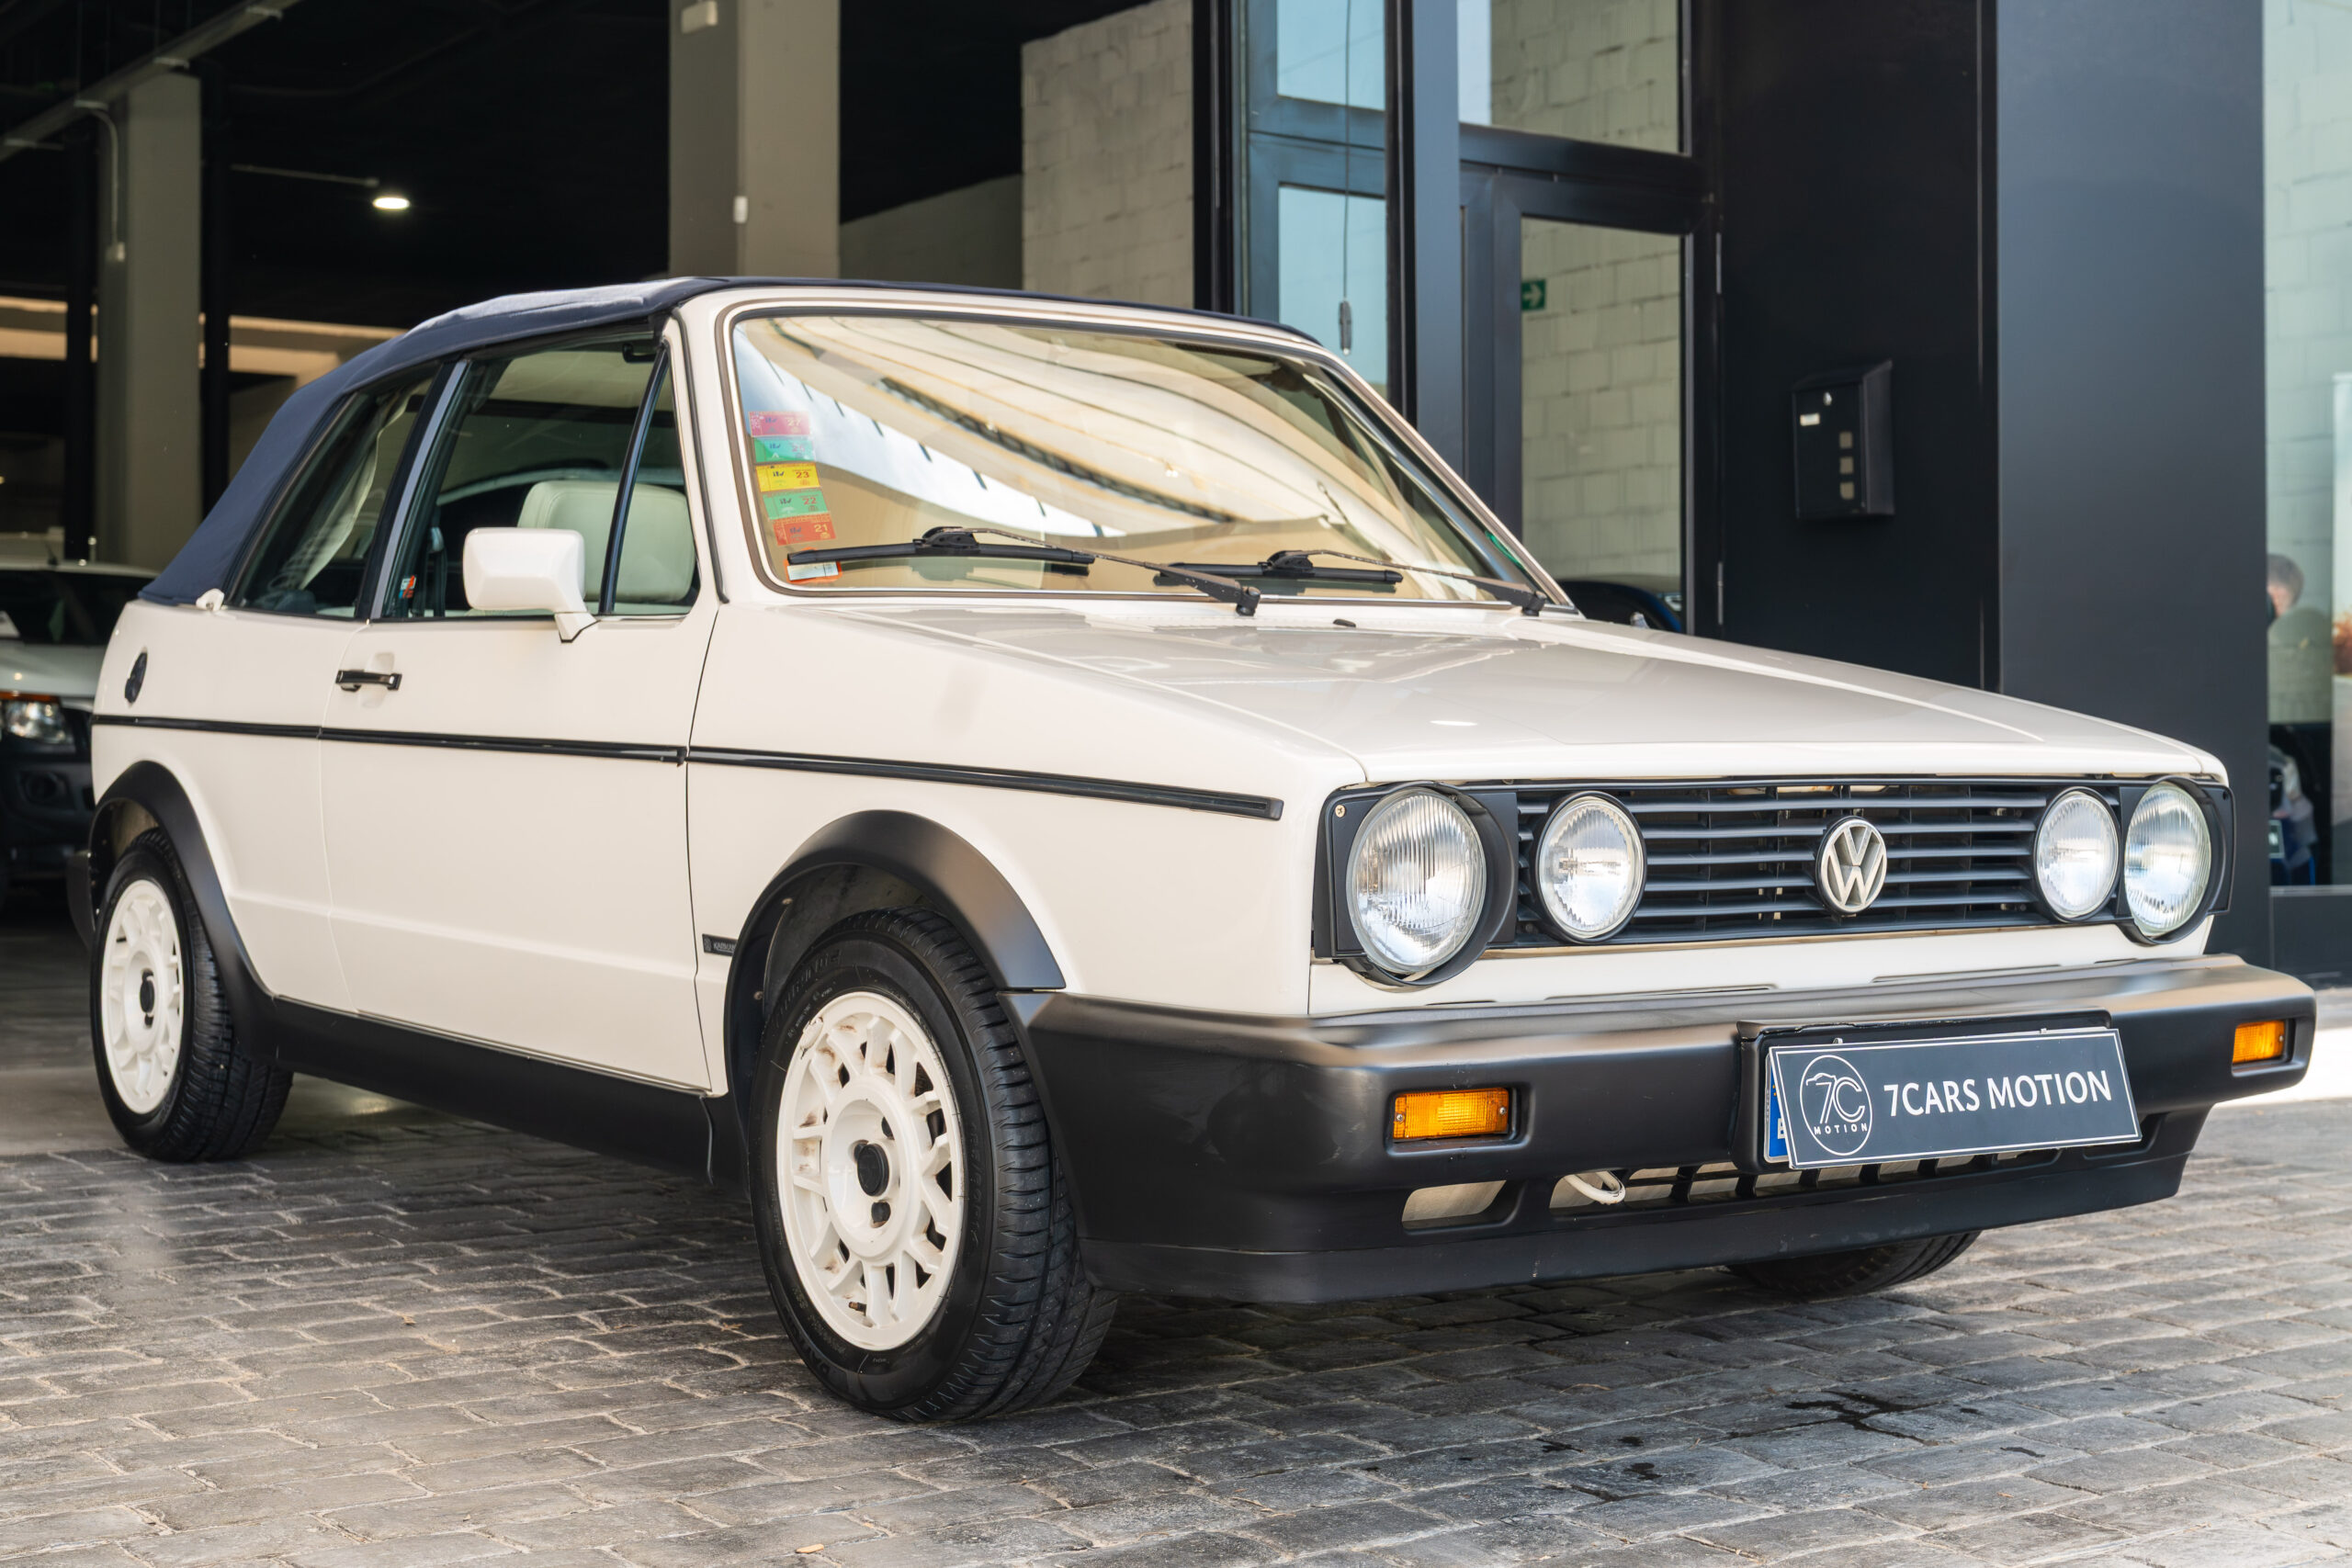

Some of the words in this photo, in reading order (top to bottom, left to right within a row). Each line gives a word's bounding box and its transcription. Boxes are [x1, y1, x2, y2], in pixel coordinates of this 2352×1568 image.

[795, 470, 810, 479] 23
[802, 496, 817, 505] 22
[813, 524, 829, 533] 21
[1883, 1078, 1981, 1117] 7CARS
[1986, 1070, 2112, 1110] MOTION
[1814, 1122, 1868, 1135] MOTION
